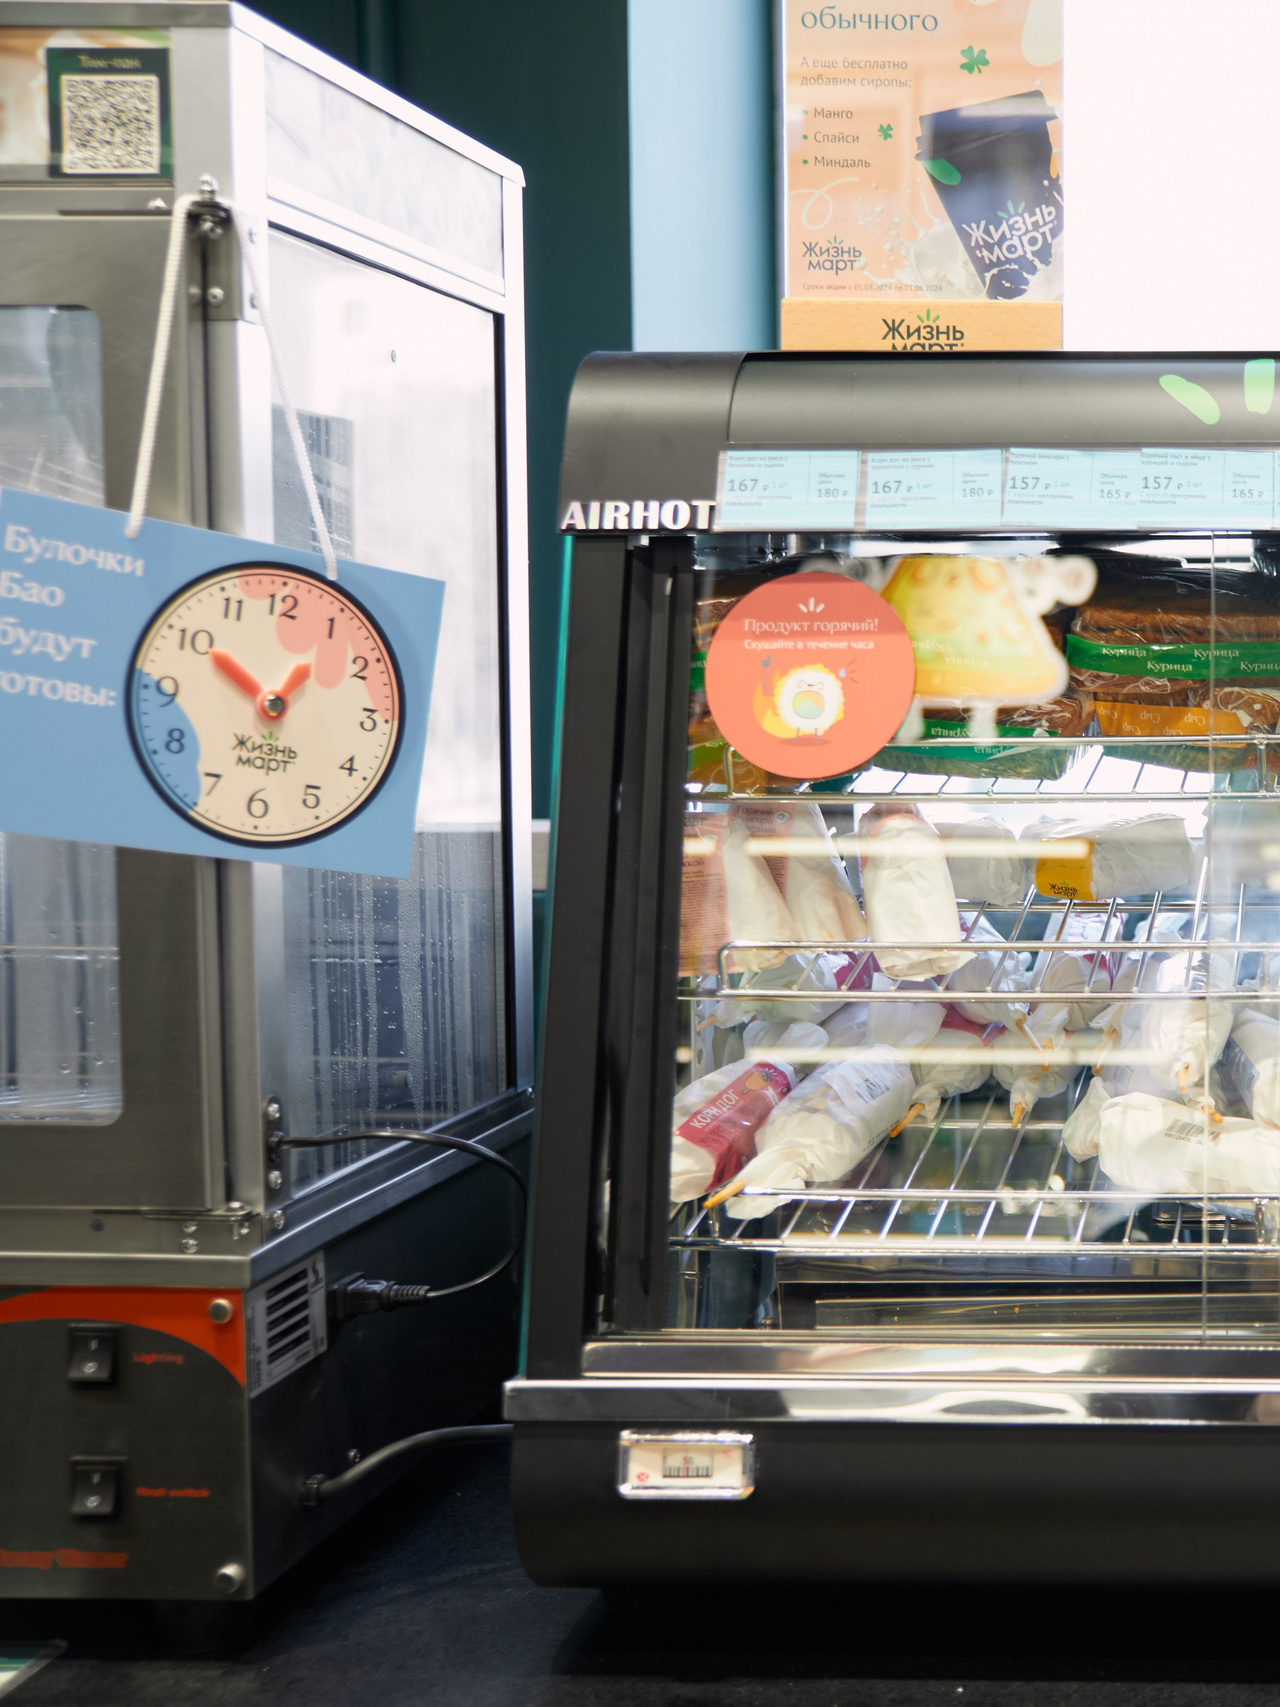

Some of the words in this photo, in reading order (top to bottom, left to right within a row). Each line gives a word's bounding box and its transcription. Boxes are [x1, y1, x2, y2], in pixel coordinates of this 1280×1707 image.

[801, 6, 938, 31] обычного
[801, 57, 810, 68] А
[842, 57, 908, 70] бесплатно
[801, 75, 856, 87] добавим
[861, 77, 912, 90] сиропы:
[814, 108, 853, 121] Манго
[814, 131, 860, 145] Спайси
[814, 155, 871, 169] Миндаль
[962, 203, 1056, 247] Жизнь
[802, 242, 862, 258] Жизнь
[982, 222, 1057, 264] март
[807, 259, 861, 276] март
[803, 283, 824, 291] Сроки
[882, 318, 965, 341] Жизнь
[728, 479, 759, 492] 167
[817, 488, 839, 498] 180
[872, 480, 902, 494] 167
[962, 488, 984, 498] 180
[1010, 477, 1041, 490] 157
[1142, 476, 1172, 489] 157
[1232, 489, 1254, 498] 165
[1100, 489, 1121, 499] 165
[561, 501, 717, 530] AIRHOT
[4, 524, 145, 577] Булочки
[0, 570, 66, 607] Бао
[223, 597, 243, 622] 11
[269, 593, 299, 620] 12
[327, 617, 335, 639] 1
[744, 619, 809, 635] Продукт
[814, 618, 879, 635] горячий!
[0, 617, 98, 661] будут
[179, 629, 215, 655] 10
[745, 639, 796, 651] Скушайте
[797, 641, 804, 649] в
[806, 641, 847, 650] течение
[850, 642, 875, 650] часа
[1102, 647, 1147, 658] Курица
[1194, 648, 1239, 661] Курица
[351, 656, 369, 680] 2
[1147, 661, 1193, 673] Курица
[0, 671, 118, 707] отовы:
[156, 676, 178, 707] 9
[359, 708, 377, 732] 3
[1140, 710, 1160, 723] Сыр
[1184, 713, 1206, 726] Сыр
[165, 728, 185, 753] 8
[232, 734, 297, 760] Жизнь
[236, 754, 292, 776] март
[339, 755, 358, 778] 4
[204, 772, 223, 797] 7
[247, 788, 269, 818] 6
[302, 785, 321, 809] 5
[716, 1089, 739, 1113] ДОГ
[690, 1106, 722, 1129] КОРН
